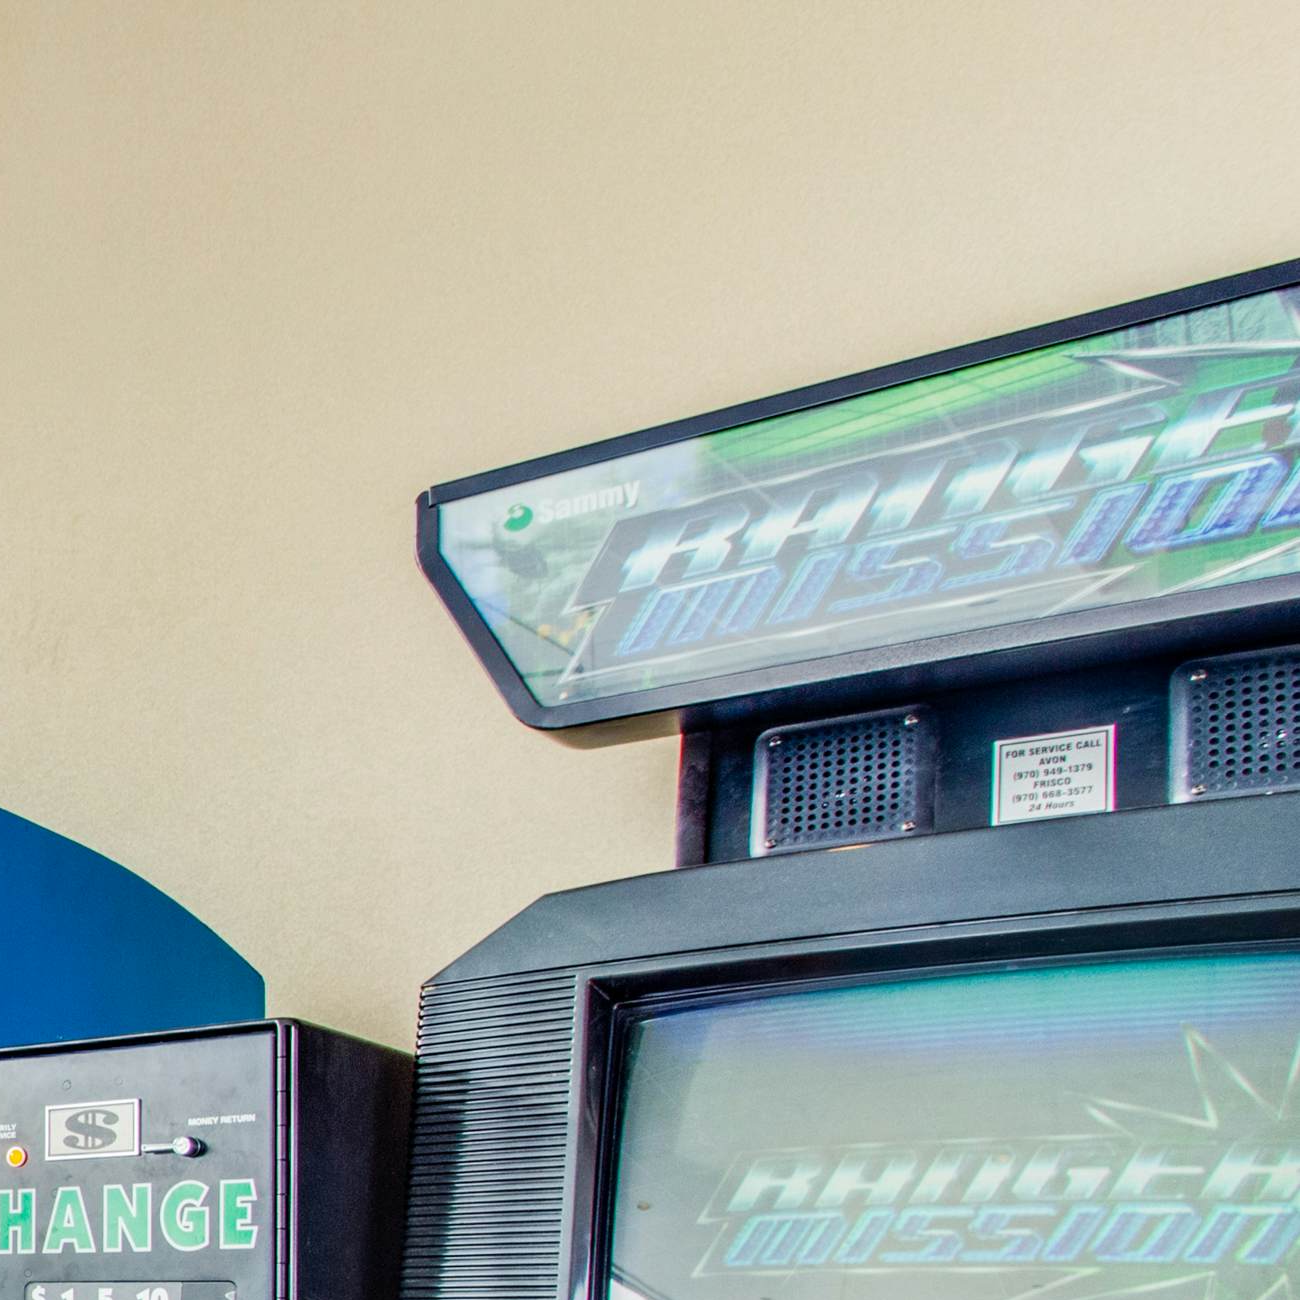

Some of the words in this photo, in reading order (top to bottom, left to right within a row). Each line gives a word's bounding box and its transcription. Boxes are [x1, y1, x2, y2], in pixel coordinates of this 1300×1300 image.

[538, 478, 641, 526] Sammy
[1005, 749, 1025, 759] FOR
[1029, 742, 1073, 757] SERVICE
[1076, 739, 1102, 750] CALL
[1039, 755, 1067, 766] AVON
[1013, 769, 1040, 782] (970)
[1043, 762, 1093, 777] 949-1379
[1033, 777, 1072, 789] FRISCO
[1012, 792, 1039, 804] (970)
[1044, 800, 1075, 811] Hours
[188, 1116, 218, 1126] MONEY
[220, 1113, 256, 1124] RETURN
